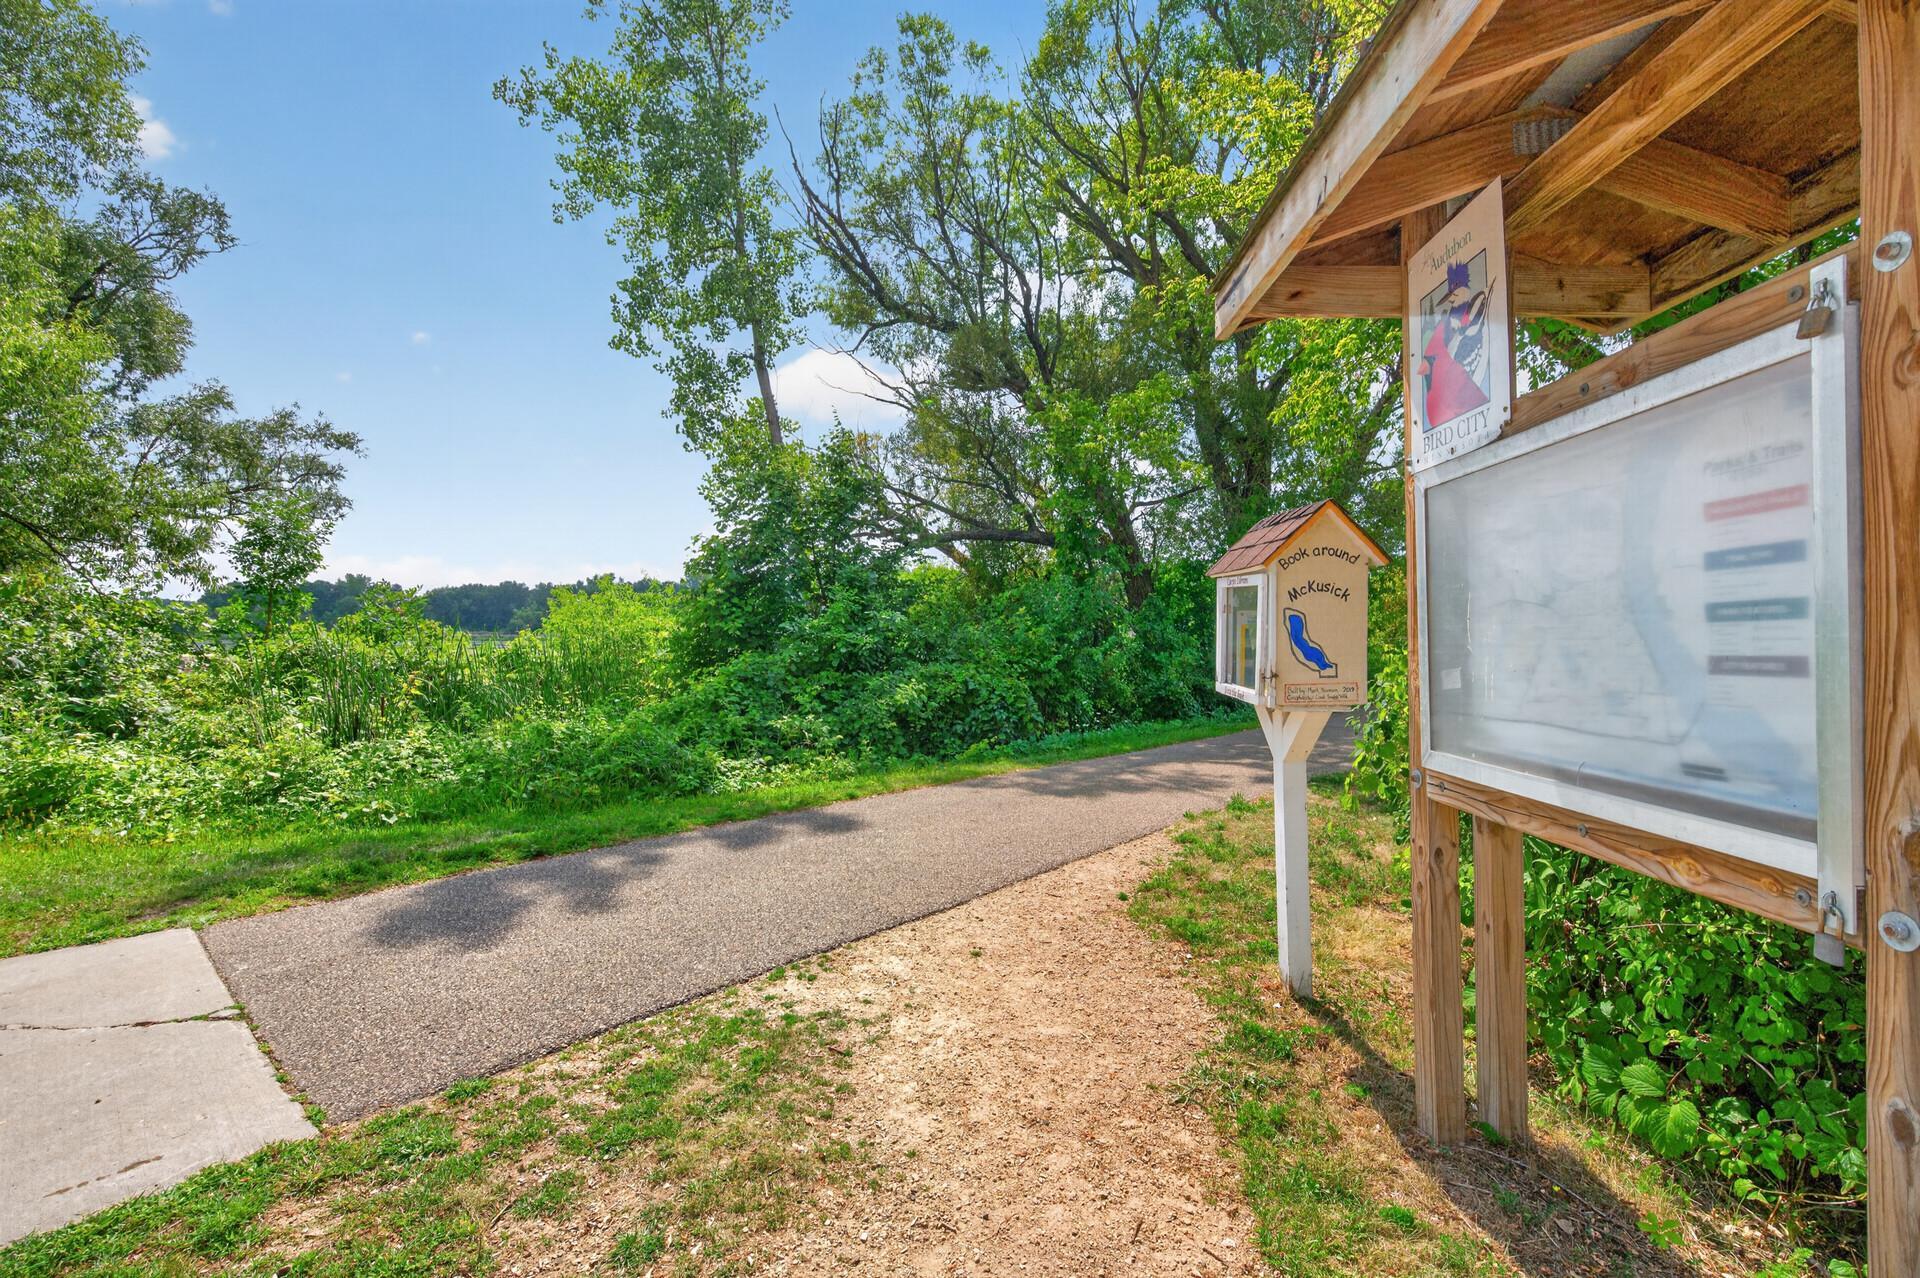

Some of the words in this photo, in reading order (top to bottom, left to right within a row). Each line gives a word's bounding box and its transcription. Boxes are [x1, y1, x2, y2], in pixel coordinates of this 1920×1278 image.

[1430, 231, 1472, 275] Audubon
[1423, 425, 1454, 454] BIRD
[1457, 407, 1490, 439] CITY
[1278, 547, 1309, 570] Book
[1312, 546, 1360, 564] around
[1287, 580, 1350, 602] McKusick
